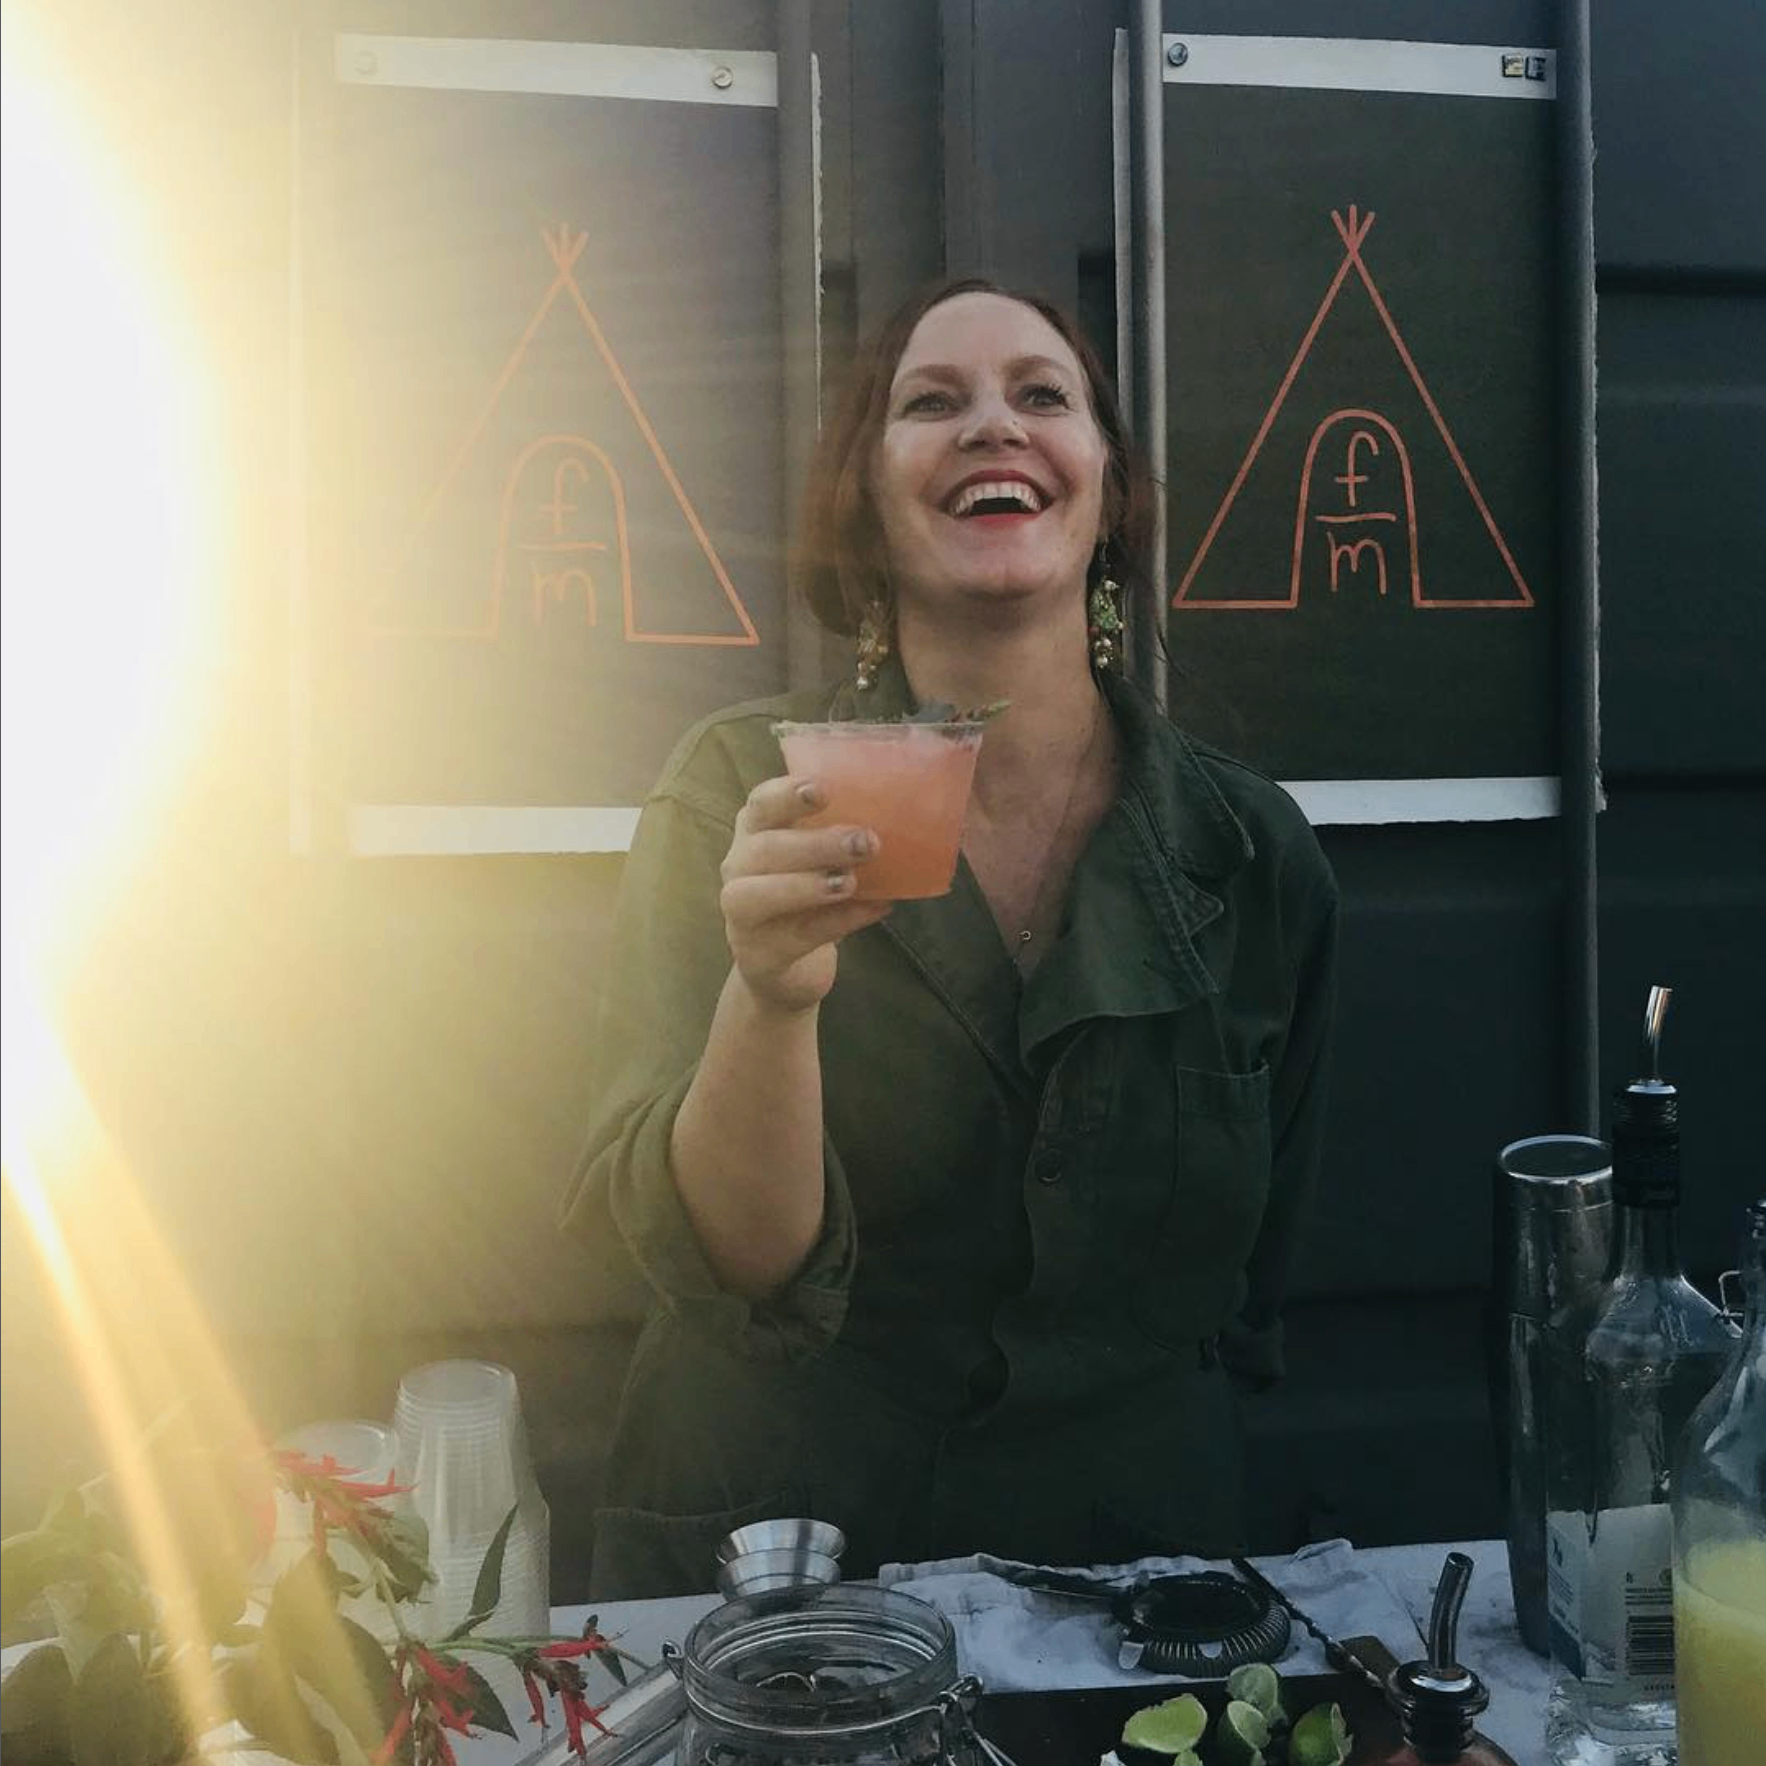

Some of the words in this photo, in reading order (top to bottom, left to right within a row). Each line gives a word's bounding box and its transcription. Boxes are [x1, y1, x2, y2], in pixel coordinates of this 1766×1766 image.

[537, 457, 590, 536] f
[1334, 430, 1379, 507] f
[531, 560, 597, 627] m
[1326, 531, 1387, 594] m
